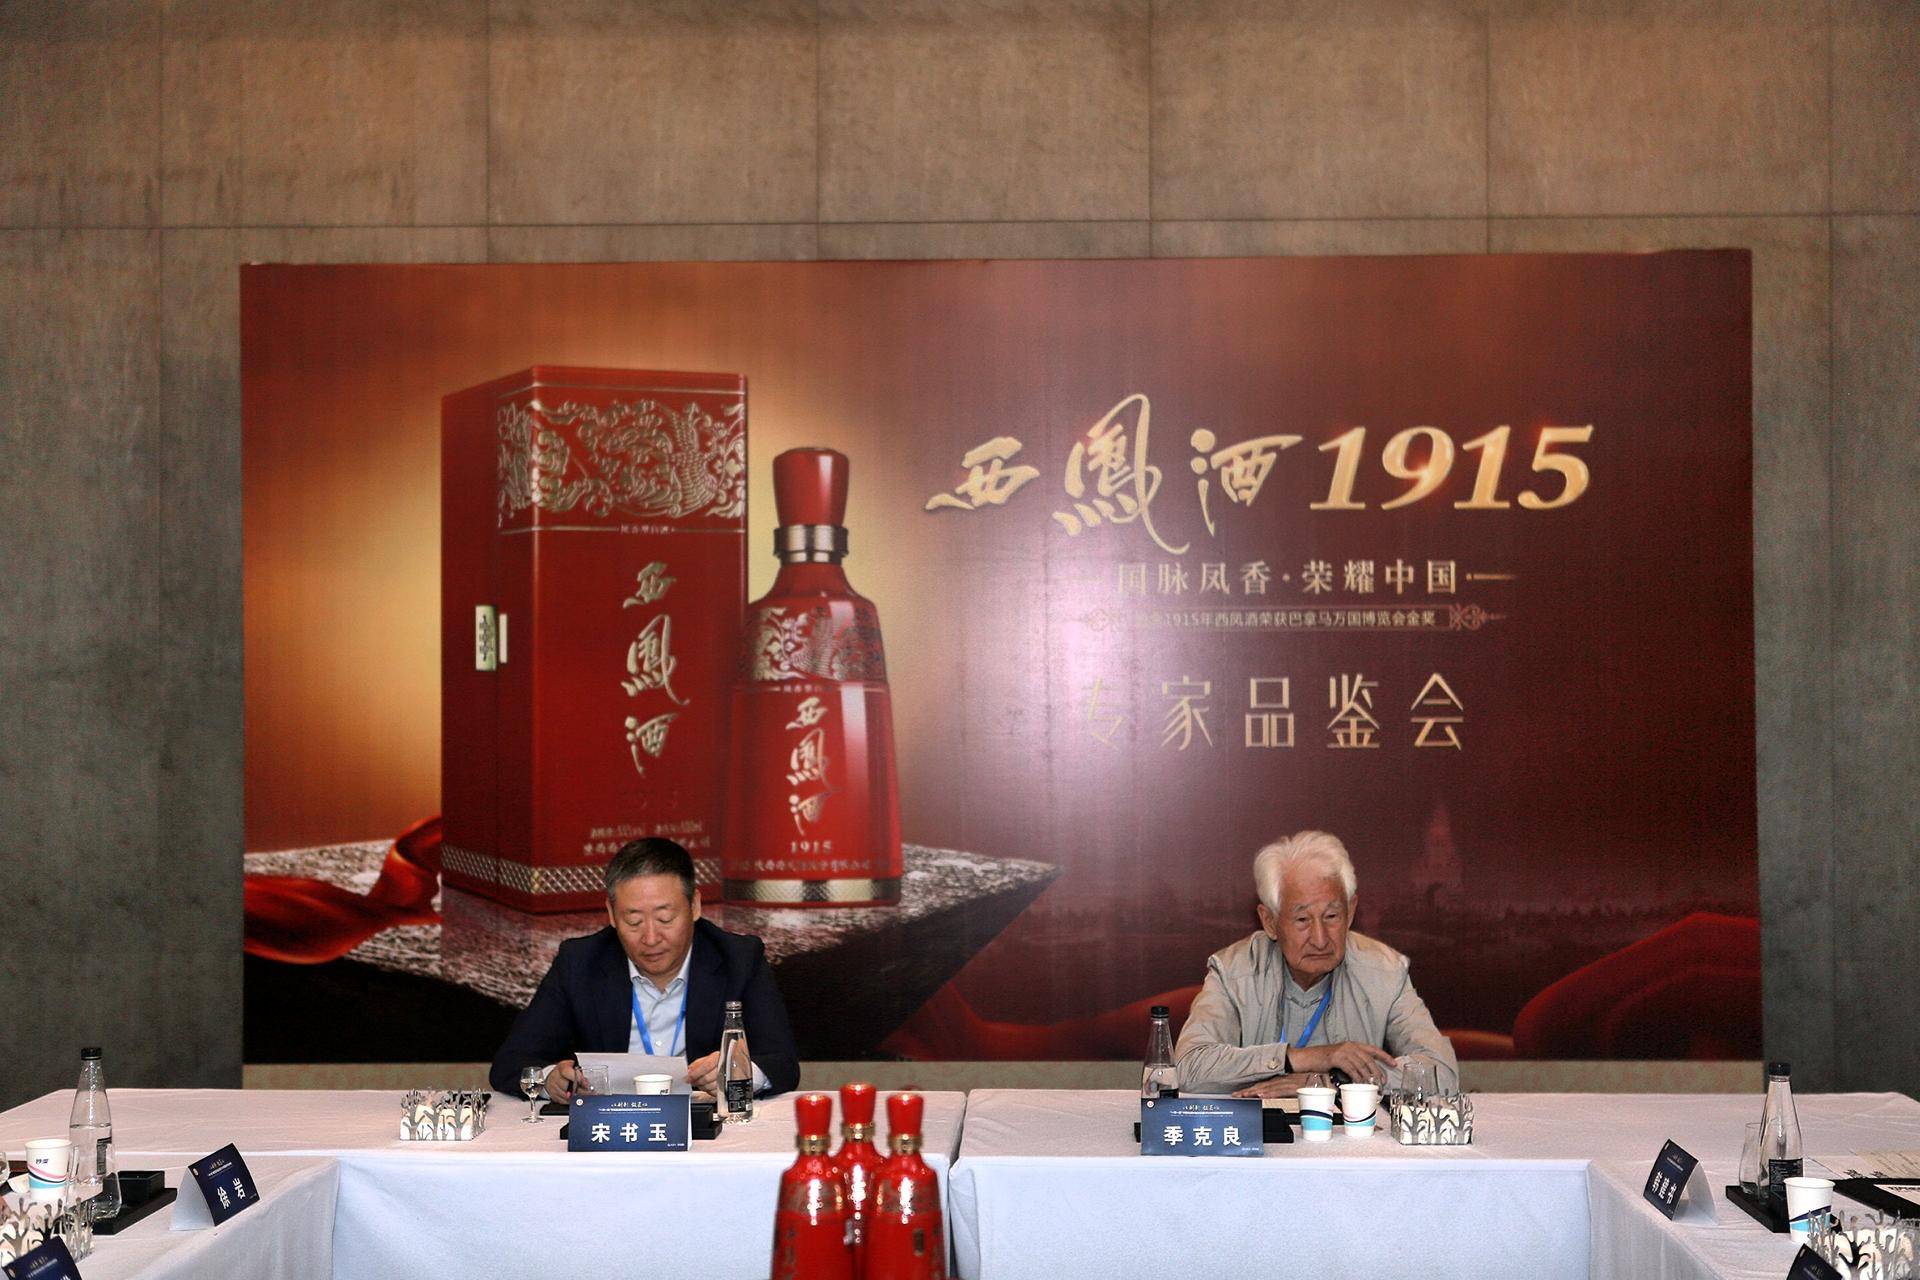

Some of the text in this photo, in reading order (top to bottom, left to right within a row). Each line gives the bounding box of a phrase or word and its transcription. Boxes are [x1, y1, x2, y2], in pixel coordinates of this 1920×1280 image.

[1309, 423, 1594, 511] 1915
[1137, 610, 1436, 628] 1915年西凤酒荣获巴拿马万国博览会金奖
[1082, 672, 1466, 751] 专家品鉴会
[790, 840, 833, 854] 1915
[591, 1122, 668, 1143] 宋书玉
[1163, 1125, 1242, 1147] 季克良
